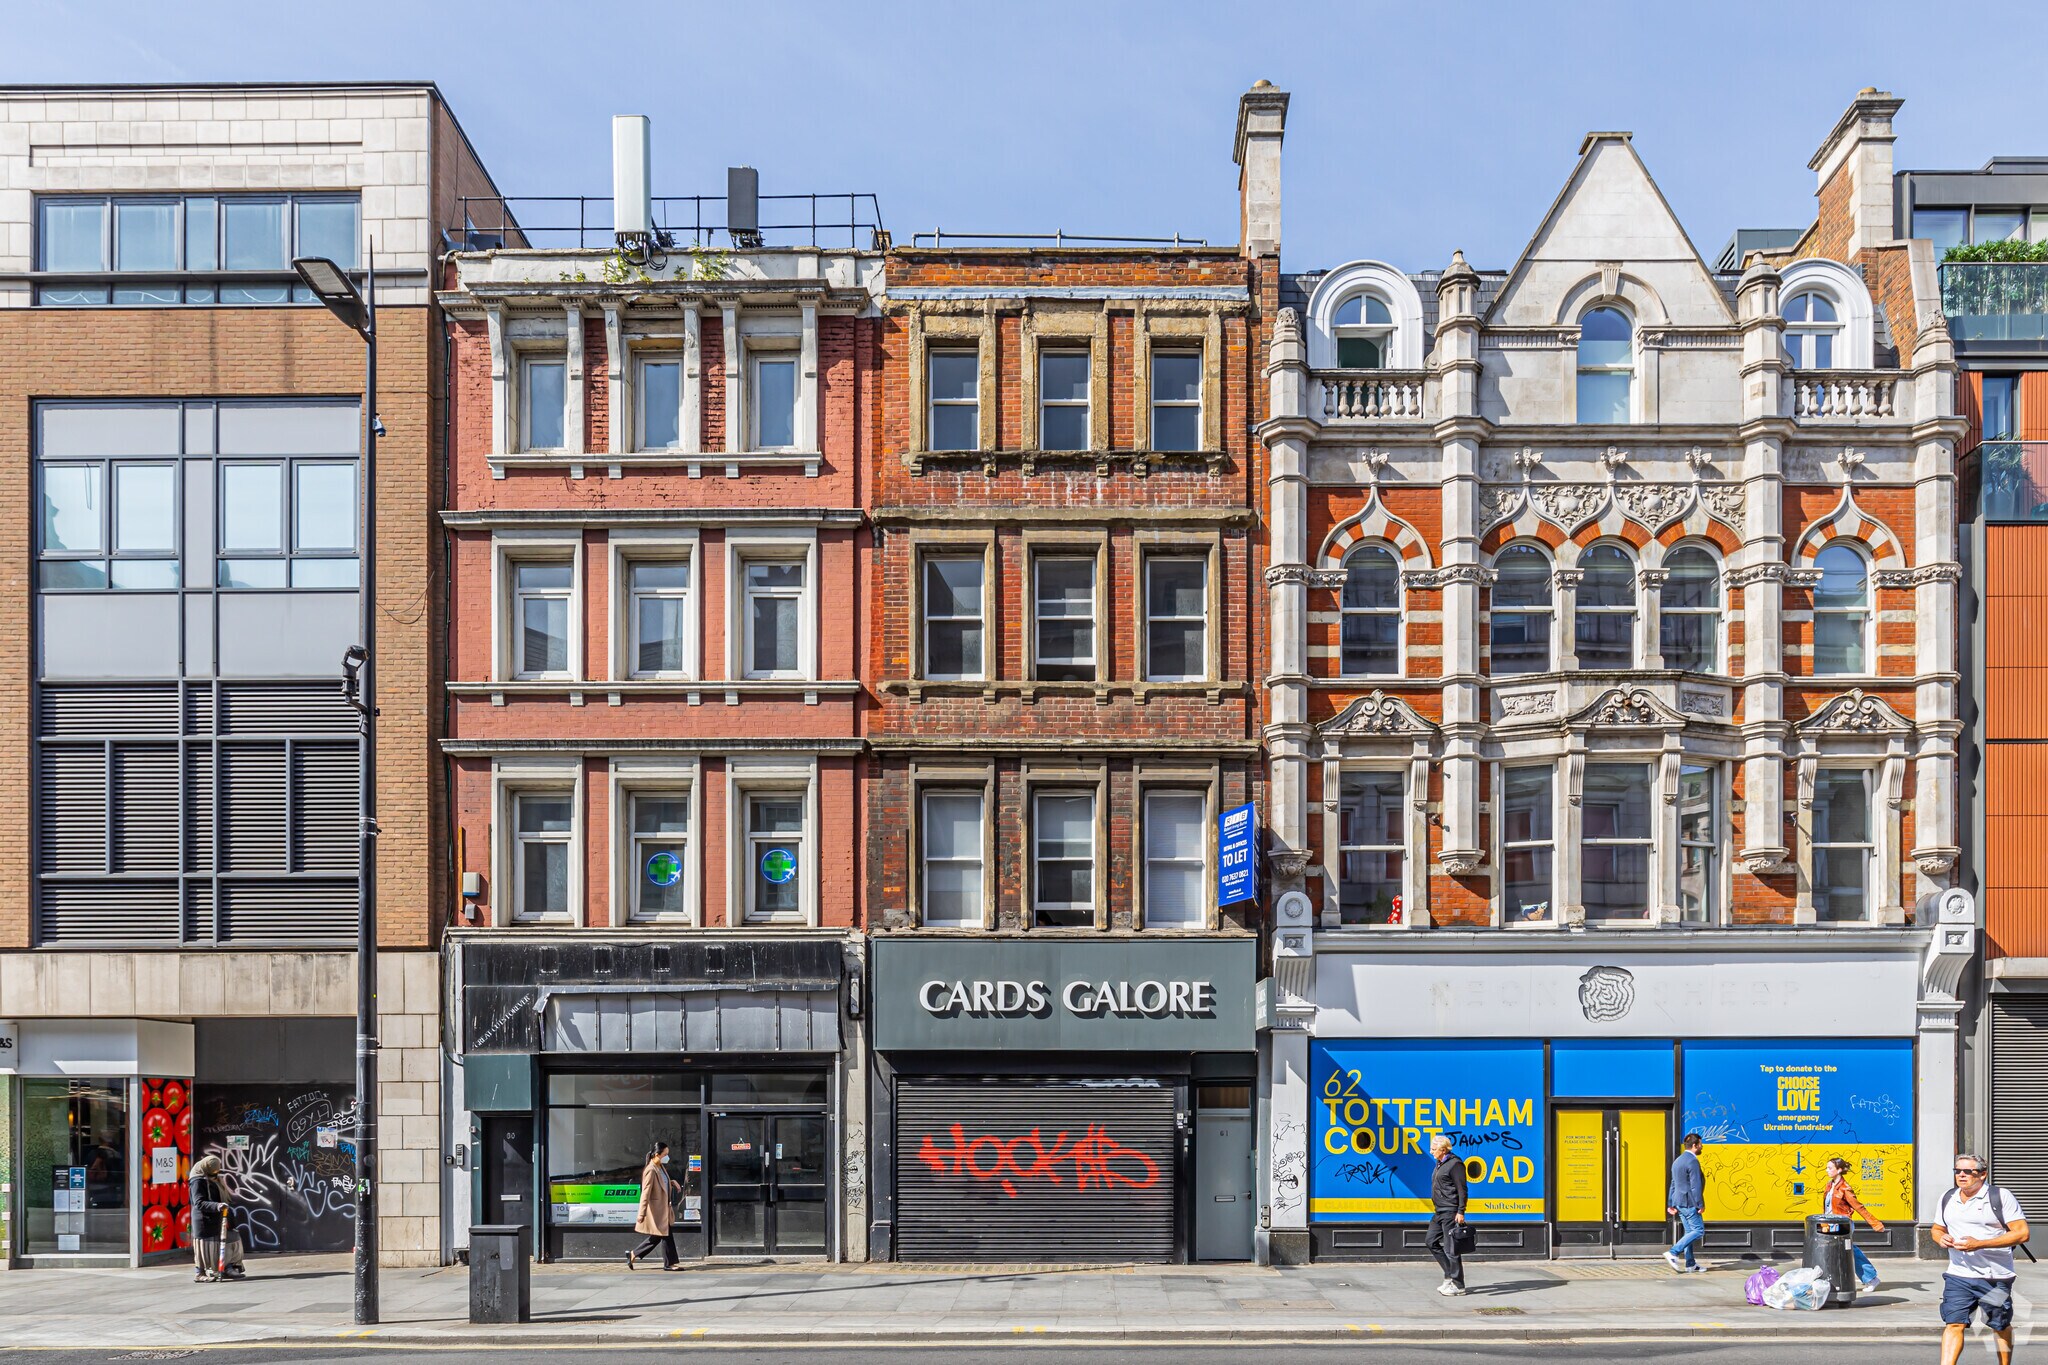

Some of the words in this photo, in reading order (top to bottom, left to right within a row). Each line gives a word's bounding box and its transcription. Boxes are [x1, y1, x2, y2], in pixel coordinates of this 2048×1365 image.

[1222, 853, 1233, 868] TO
[1234, 848, 1248, 864] LET
[919, 980, 1045, 1012] CARDS
[1063, 980, 1212, 1012] GALORE
[1760, 1065, 1774, 1074] Tap
[1324, 1069, 1362, 1097] 62
[1777, 1076, 1820, 1089] CHOOSE
[1777, 1089, 1820, 1111] LOVE
[1323, 1098, 1533, 1126] TOTTENHAM
[1777, 1114, 1820, 1122] emergency
[1219, 1129, 1229, 1137] 61
[1763, 1123, 1793, 1131] Ukraine
[1794, 1123, 1833, 1131] fundraiser
[1324, 1127, 1443, 1154] COURT
[155, 1157, 174, 1168] M&S
[1464, 1156, 1535, 1184] OAD
[1484, 1202, 1532, 1211] Shaftesbury
